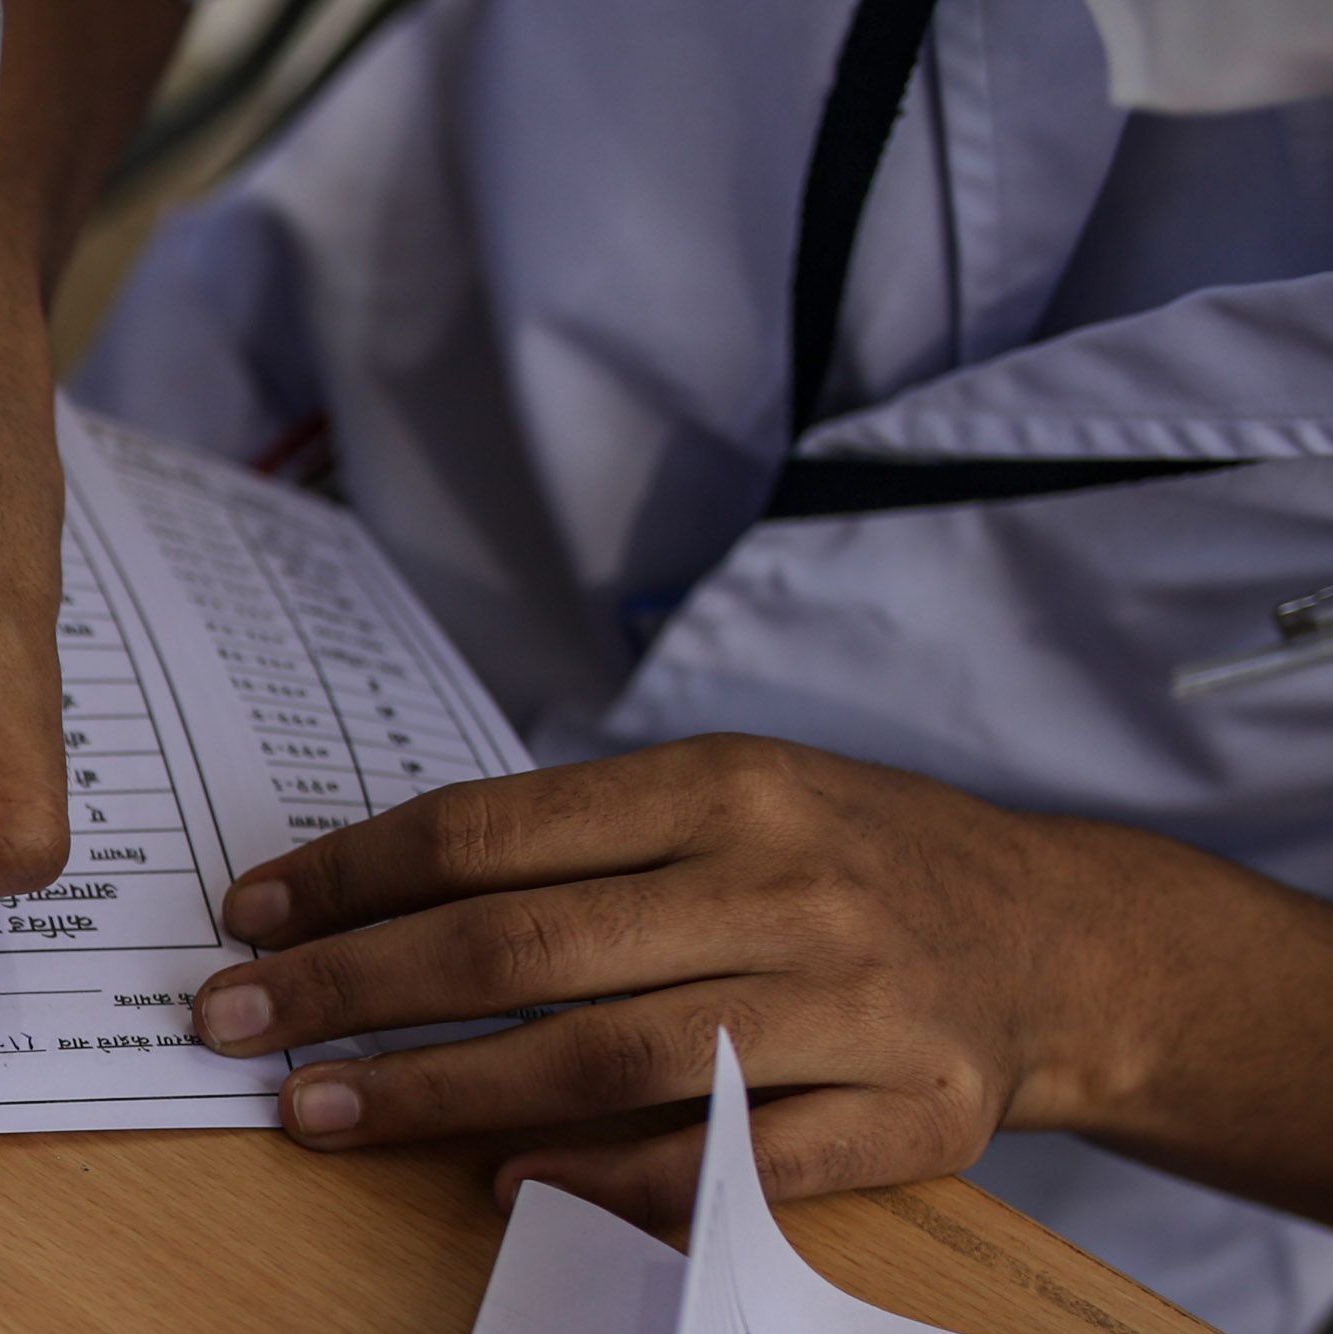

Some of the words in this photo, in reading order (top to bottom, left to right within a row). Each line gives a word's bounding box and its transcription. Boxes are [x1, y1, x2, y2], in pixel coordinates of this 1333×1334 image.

[89, 847, 148, 865] विभाग
[7, 914, 98, 939] कोविड
[57, 1037, 94, 1051] नाव
